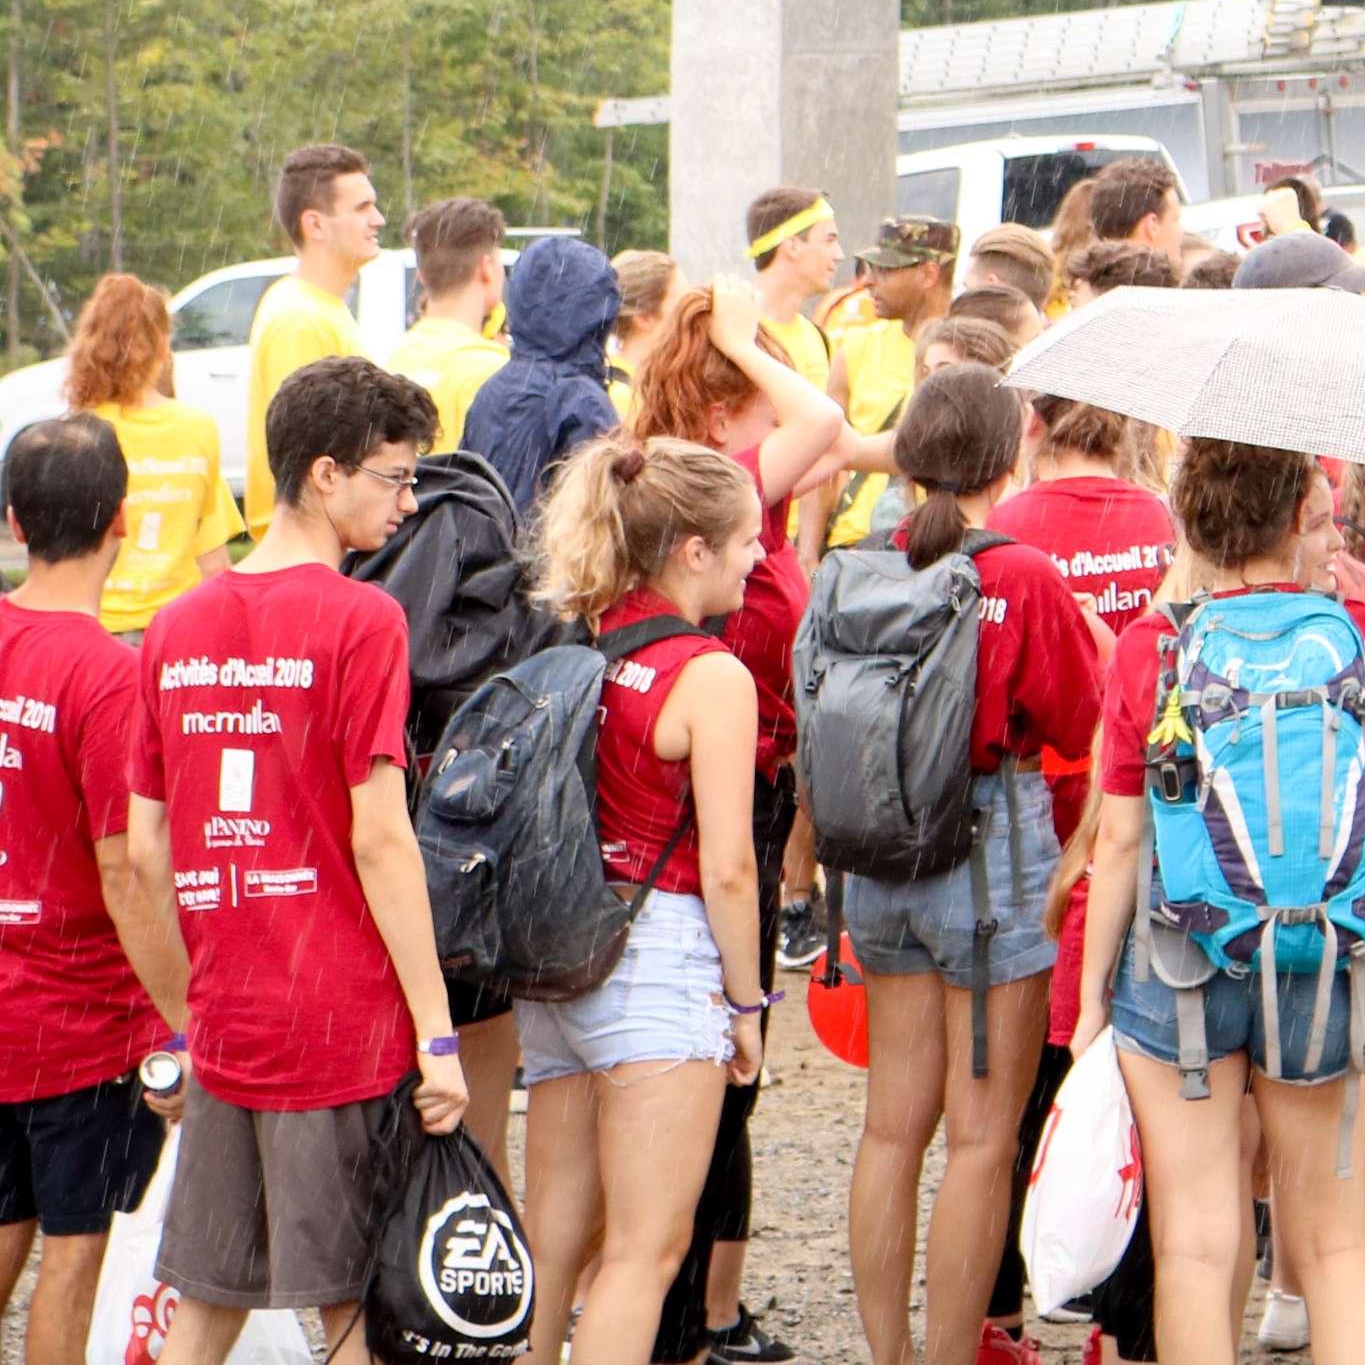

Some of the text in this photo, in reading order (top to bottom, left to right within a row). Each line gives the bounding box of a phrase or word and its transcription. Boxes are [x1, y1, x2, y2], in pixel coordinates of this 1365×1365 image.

[1071, 546, 1142, 577] d'Accueil
[978, 596, 1007, 623] 018
[1098, 582, 1152, 614] illan
[160, 655, 218, 691] Activités
[274, 658, 314, 689] 2018
[616, 660, 656, 693] 2018
[444, 1220, 520, 1270] EA
[440, 1269, 523, 1295] SPORTS
[431, 1341, 452, 1358] In
[454, 1343, 486, 1359] The
